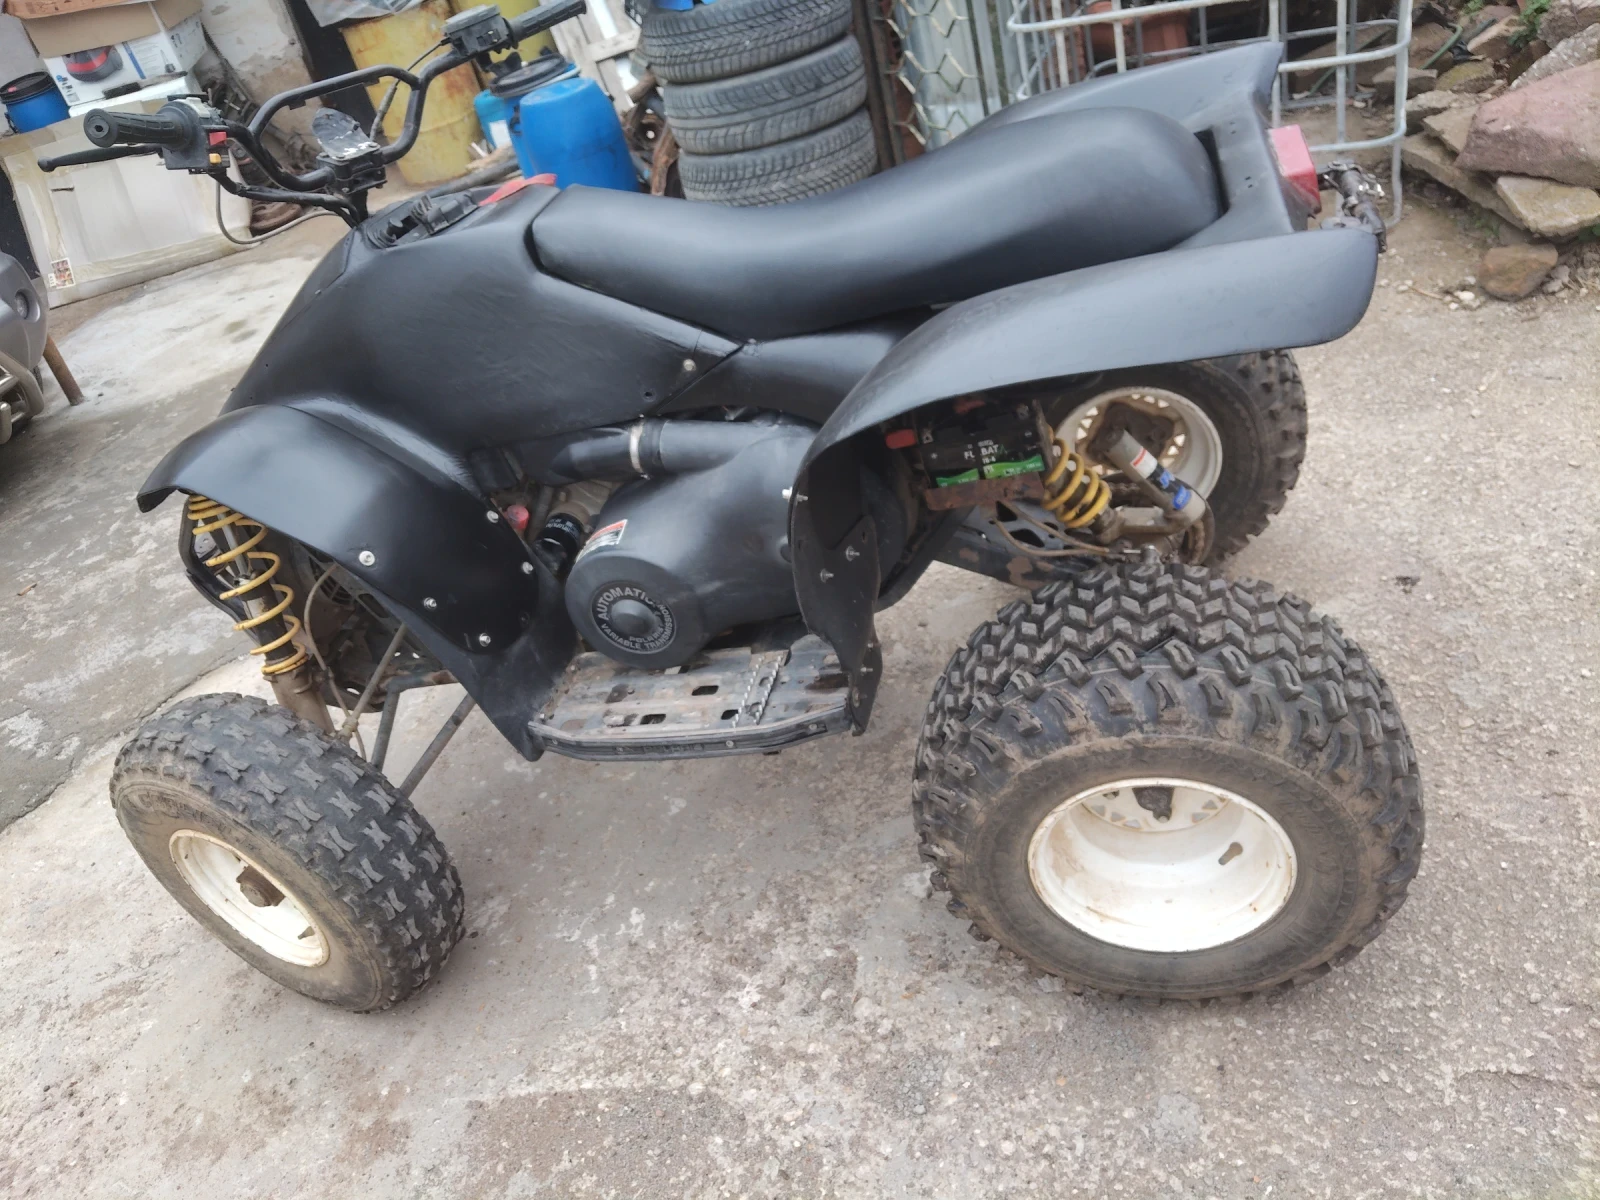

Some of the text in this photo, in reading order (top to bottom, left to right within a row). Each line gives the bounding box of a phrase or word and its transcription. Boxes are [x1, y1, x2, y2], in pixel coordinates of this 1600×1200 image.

[601, 623, 642, 649] VARIABLE
[629, 626, 664, 643] POLARIS
[643, 604, 673, 650] TRANSMISSION
